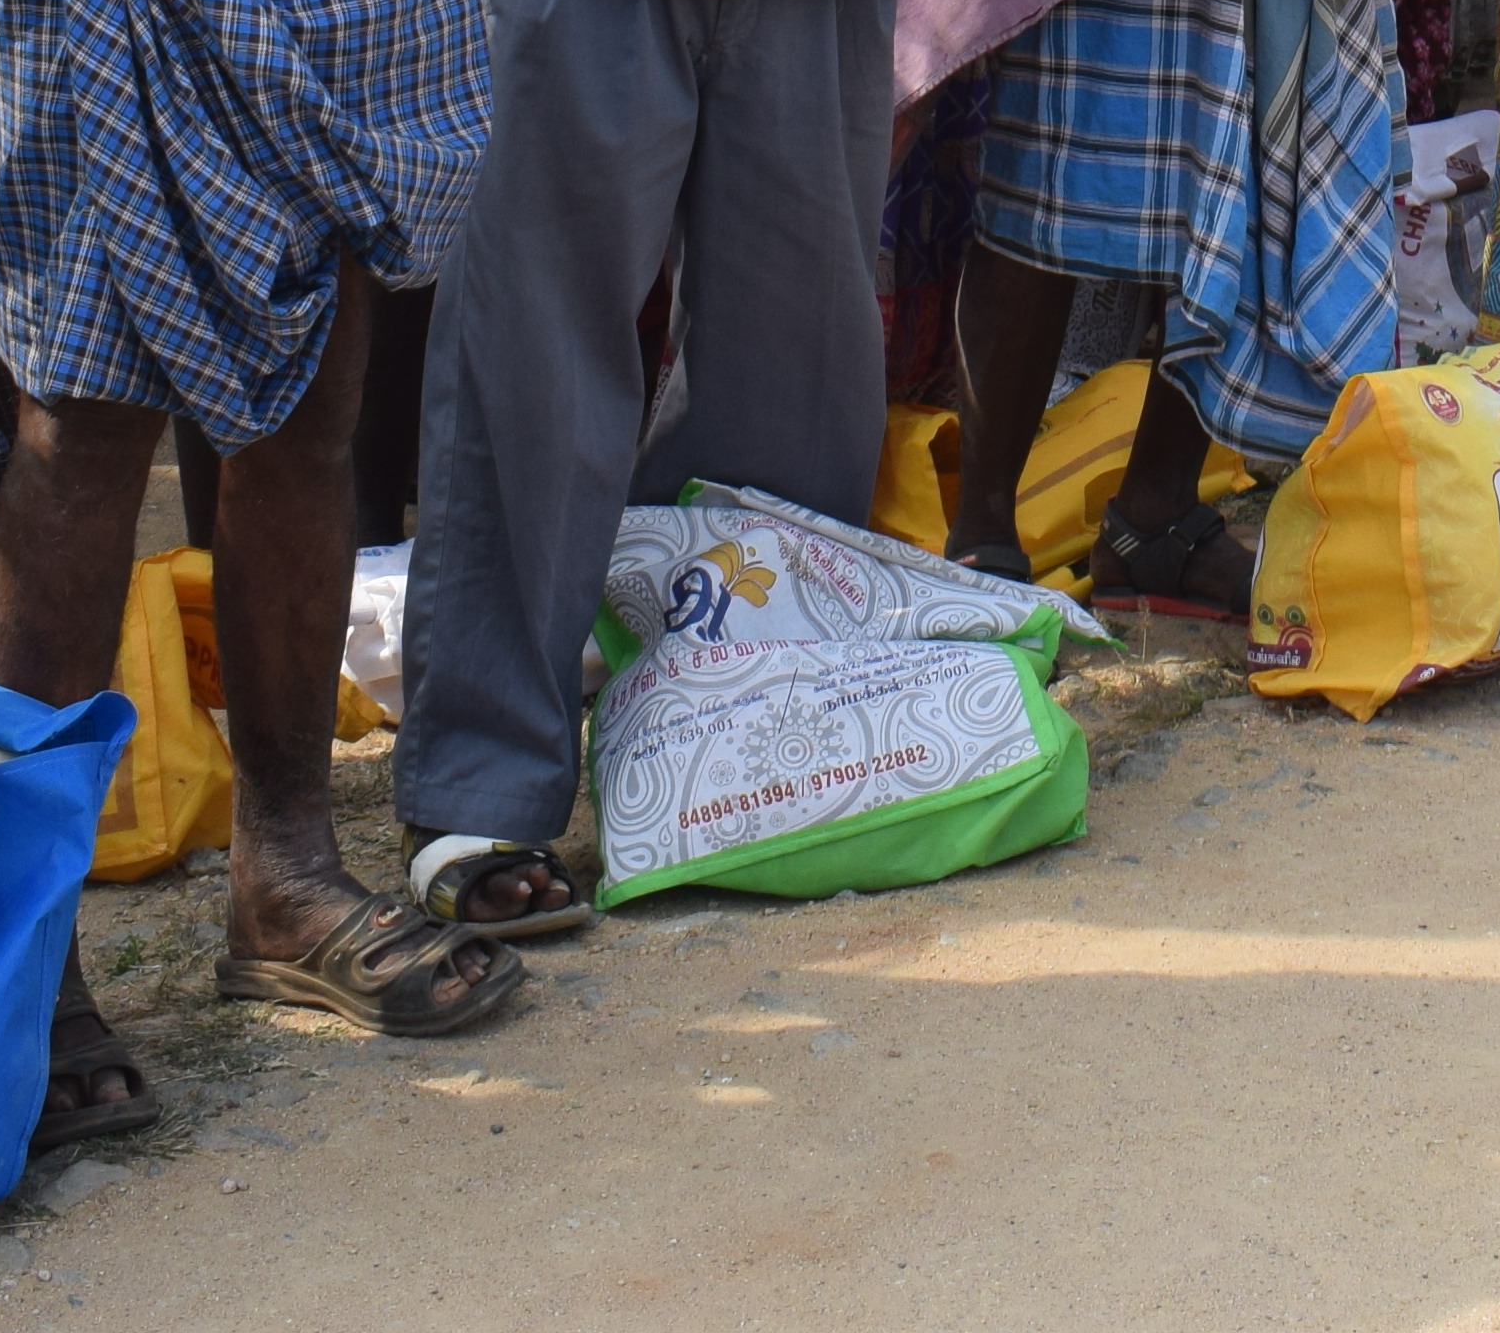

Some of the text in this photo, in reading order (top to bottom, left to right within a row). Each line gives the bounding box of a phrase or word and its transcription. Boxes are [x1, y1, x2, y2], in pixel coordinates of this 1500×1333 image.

[1401, 203, 1431, 257] CHR
[667, 658, 680, 678] &
[822, 677, 904, 715] நாமக்கல்
[914, 670, 940, 687] 637
[943, 662, 976, 678] 001.
[679, 725, 704, 745] 639
[708, 716, 740, 735] 001.
[678, 801, 735, 831] 84894
[739, 781, 795, 813] 81394
[811, 761, 868, 792] 97903
[872, 742, 929, 774] 22882
